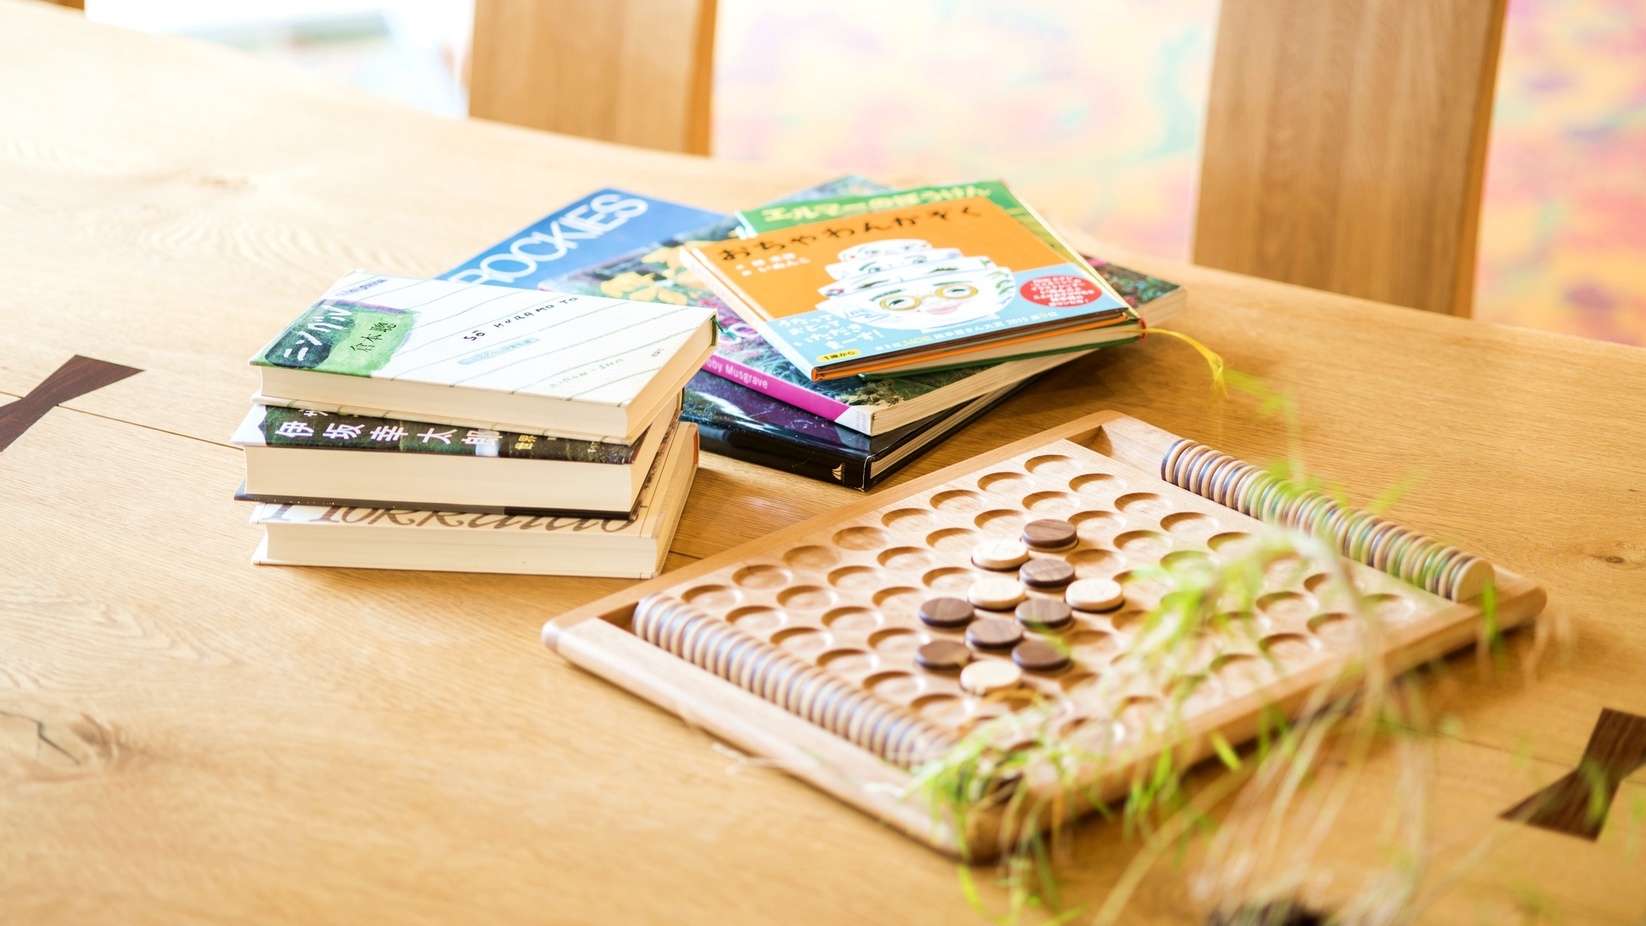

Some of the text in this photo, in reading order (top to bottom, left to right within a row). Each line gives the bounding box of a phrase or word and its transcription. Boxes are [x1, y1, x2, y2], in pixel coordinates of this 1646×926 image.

[718, 205, 983, 261] おちゃわんかぞく
[283, 304, 353, 362] ニングル
[1006, 316, 1029, 326] 2015
[725, 363, 769, 390] Musgrave
[275, 420, 503, 446] 伊坂幸太郎
